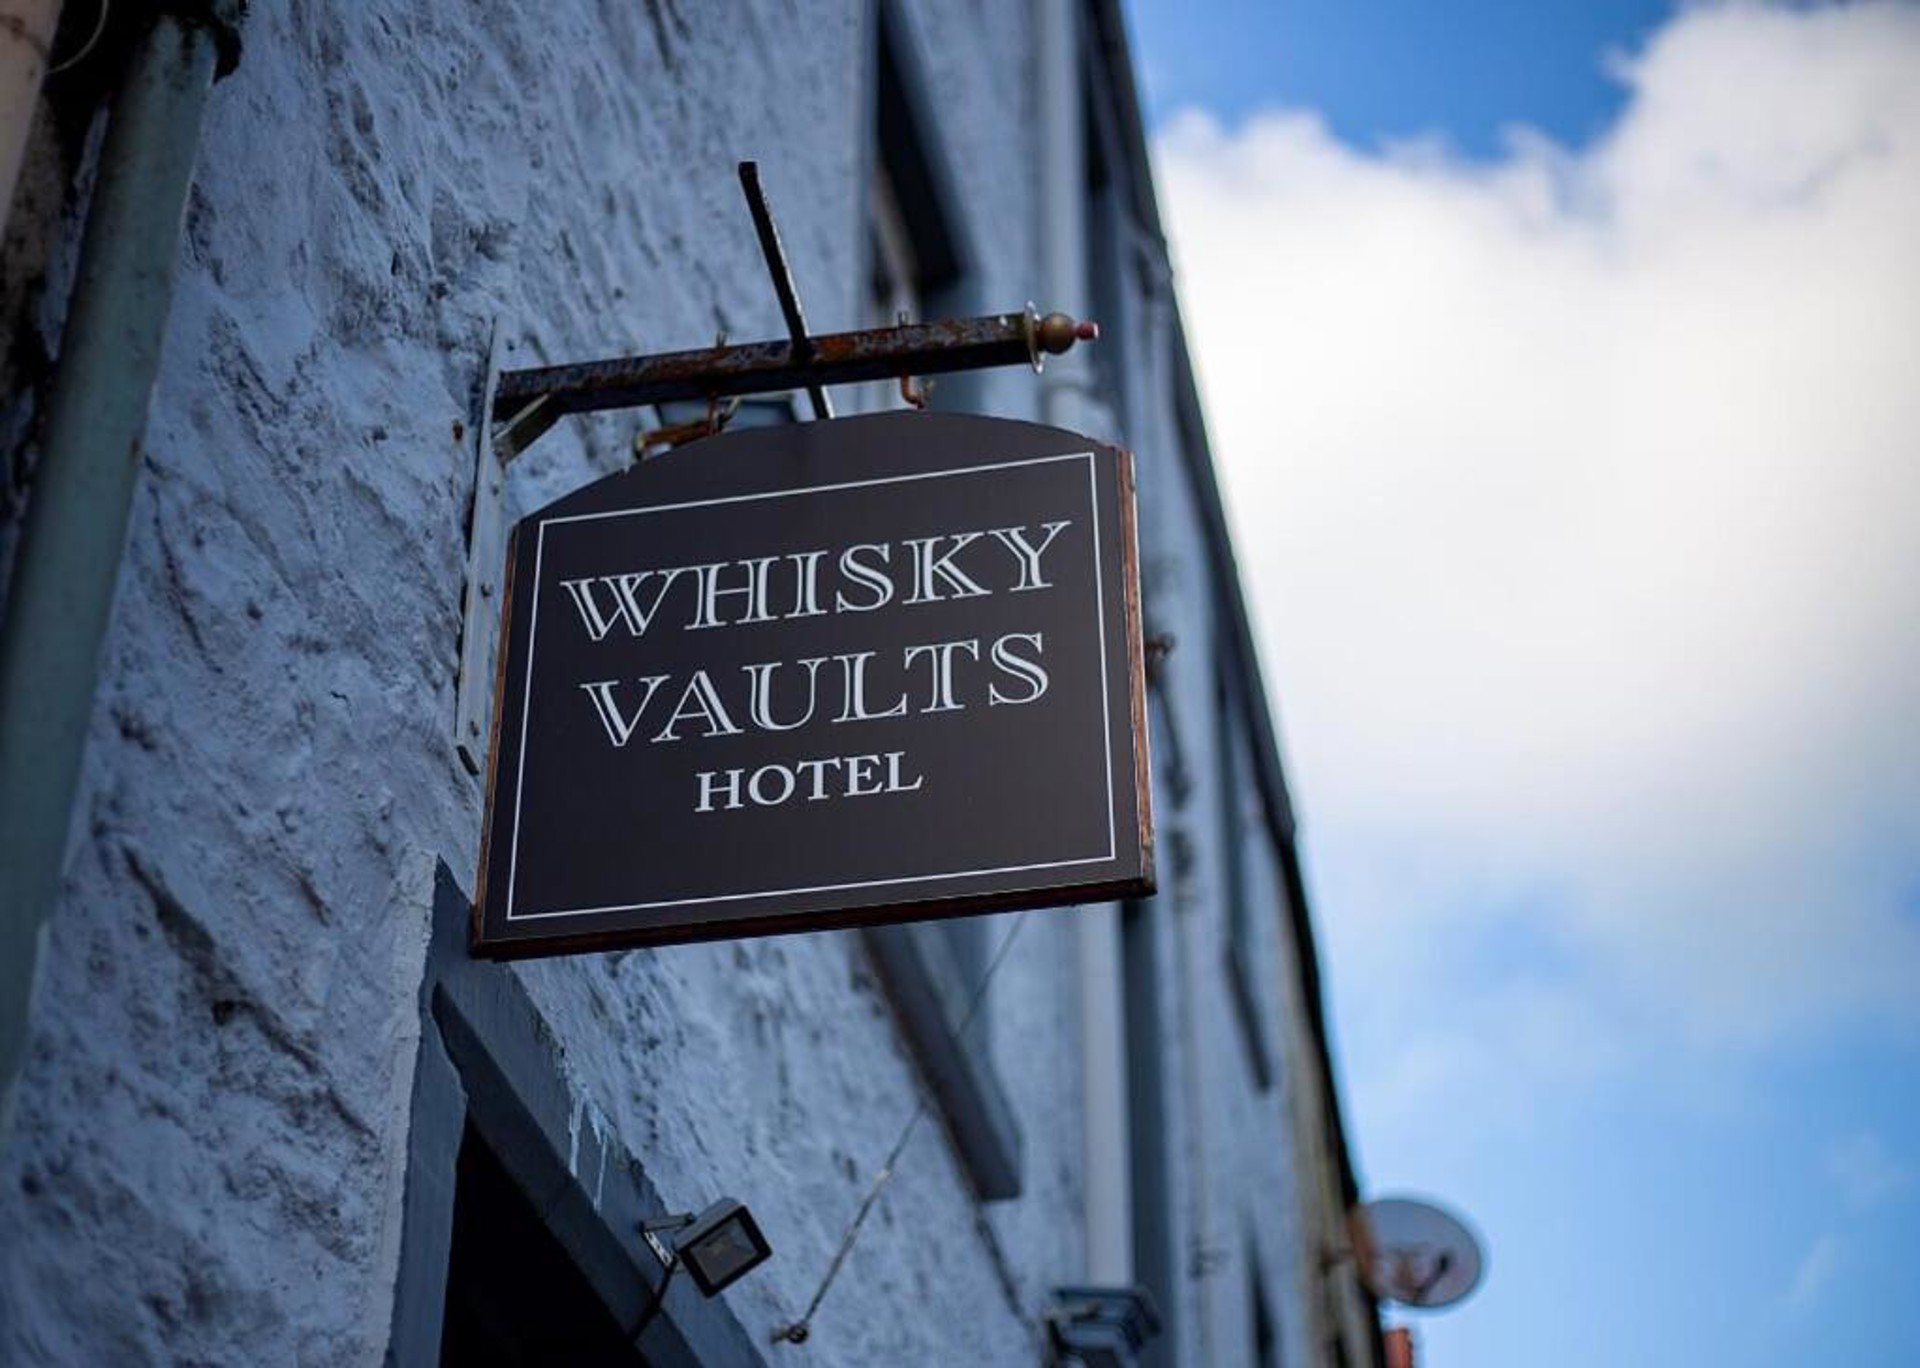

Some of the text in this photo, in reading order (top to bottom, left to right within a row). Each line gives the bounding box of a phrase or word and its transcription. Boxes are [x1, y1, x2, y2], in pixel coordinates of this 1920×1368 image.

[560, 520, 1073, 641] WHISKY
[580, 632, 1050, 747] VAULTS
[694, 751, 923, 814] HOTEL
